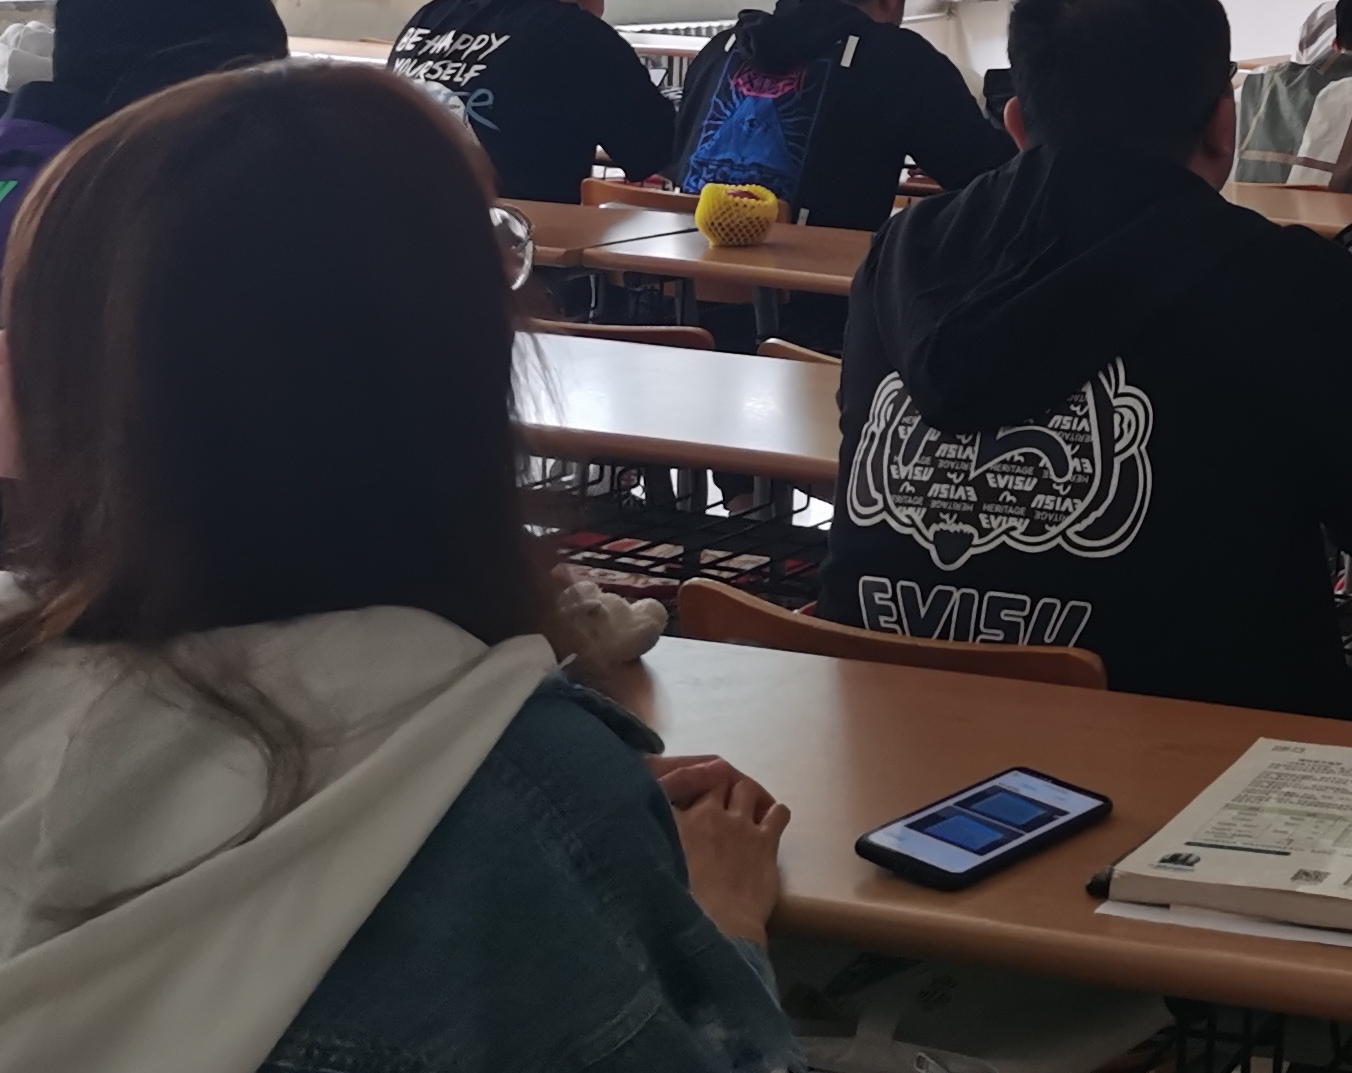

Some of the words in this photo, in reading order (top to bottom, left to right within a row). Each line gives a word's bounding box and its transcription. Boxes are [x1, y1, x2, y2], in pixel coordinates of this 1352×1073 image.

[395, 27, 431, 52] BE
[417, 30, 511, 61] HAPPY
[392, 58, 488, 87] YOURSELF
[1047, 414, 1091, 432] VISU
[927, 482, 978, 502] EVISU
[985, 472, 1038, 491] EVISU
[858, 575, 1092, 648] EVISU
